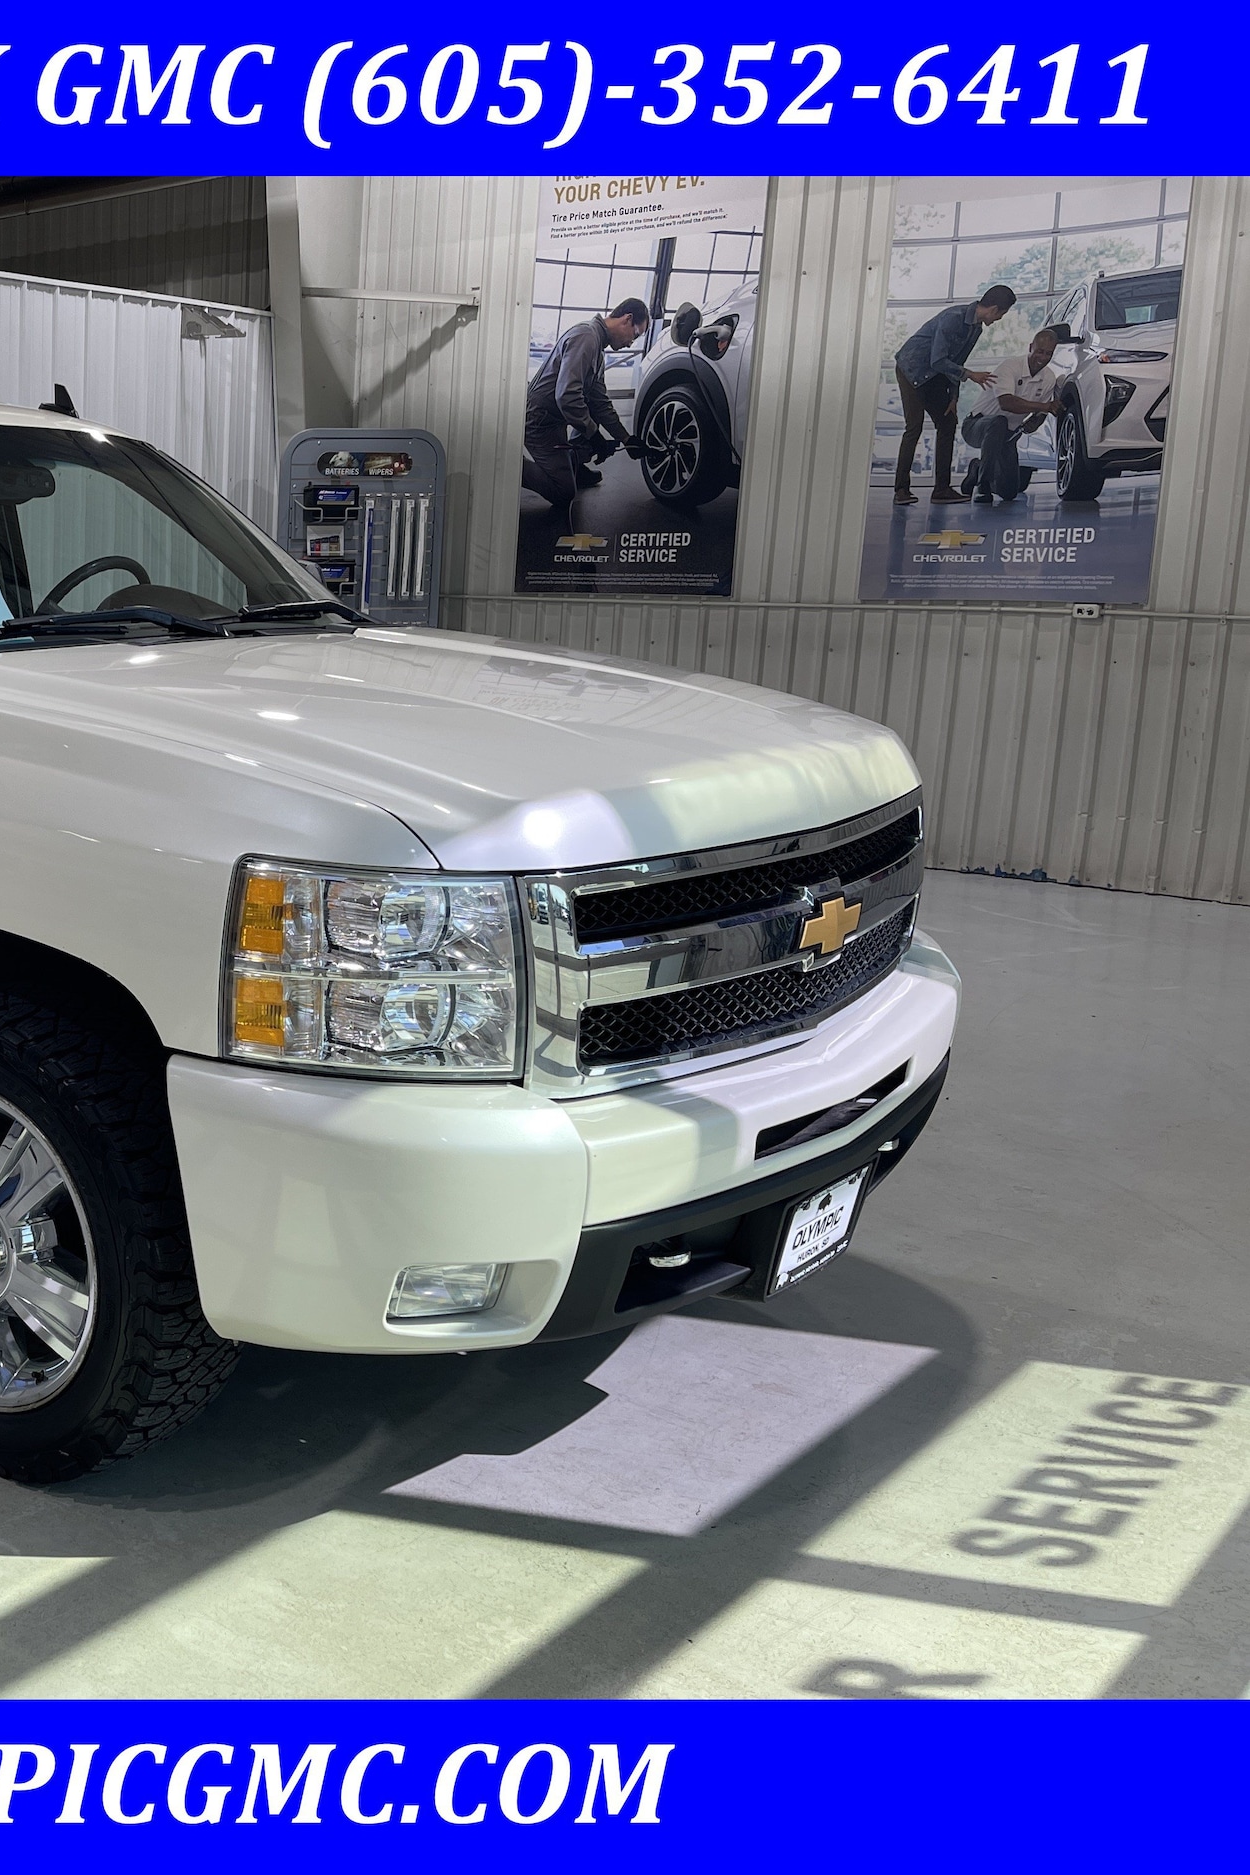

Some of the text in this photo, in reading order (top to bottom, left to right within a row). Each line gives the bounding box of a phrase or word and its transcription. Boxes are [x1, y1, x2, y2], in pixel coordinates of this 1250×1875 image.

[554, 176, 705, 204] YOUR CHEVY EV.
[552, 204, 665, 222] Tire Price Match Guarantee.
[325, 467, 359, 475] BATTERIES
[620, 532, 691, 547] CERTIFIED
[1002, 527, 1096, 545] CERTIFIED
[554, 555, 610, 563] CHEVROLET
[619, 549, 677, 563] SERVICE
[912, 554, 987, 563] CHEVROLET
[1000, 546, 1077, 563] SERVICE
[792, 1206, 844, 1251] OLYMPIC
[952, 1375, 1242, 1567] SERVICE
